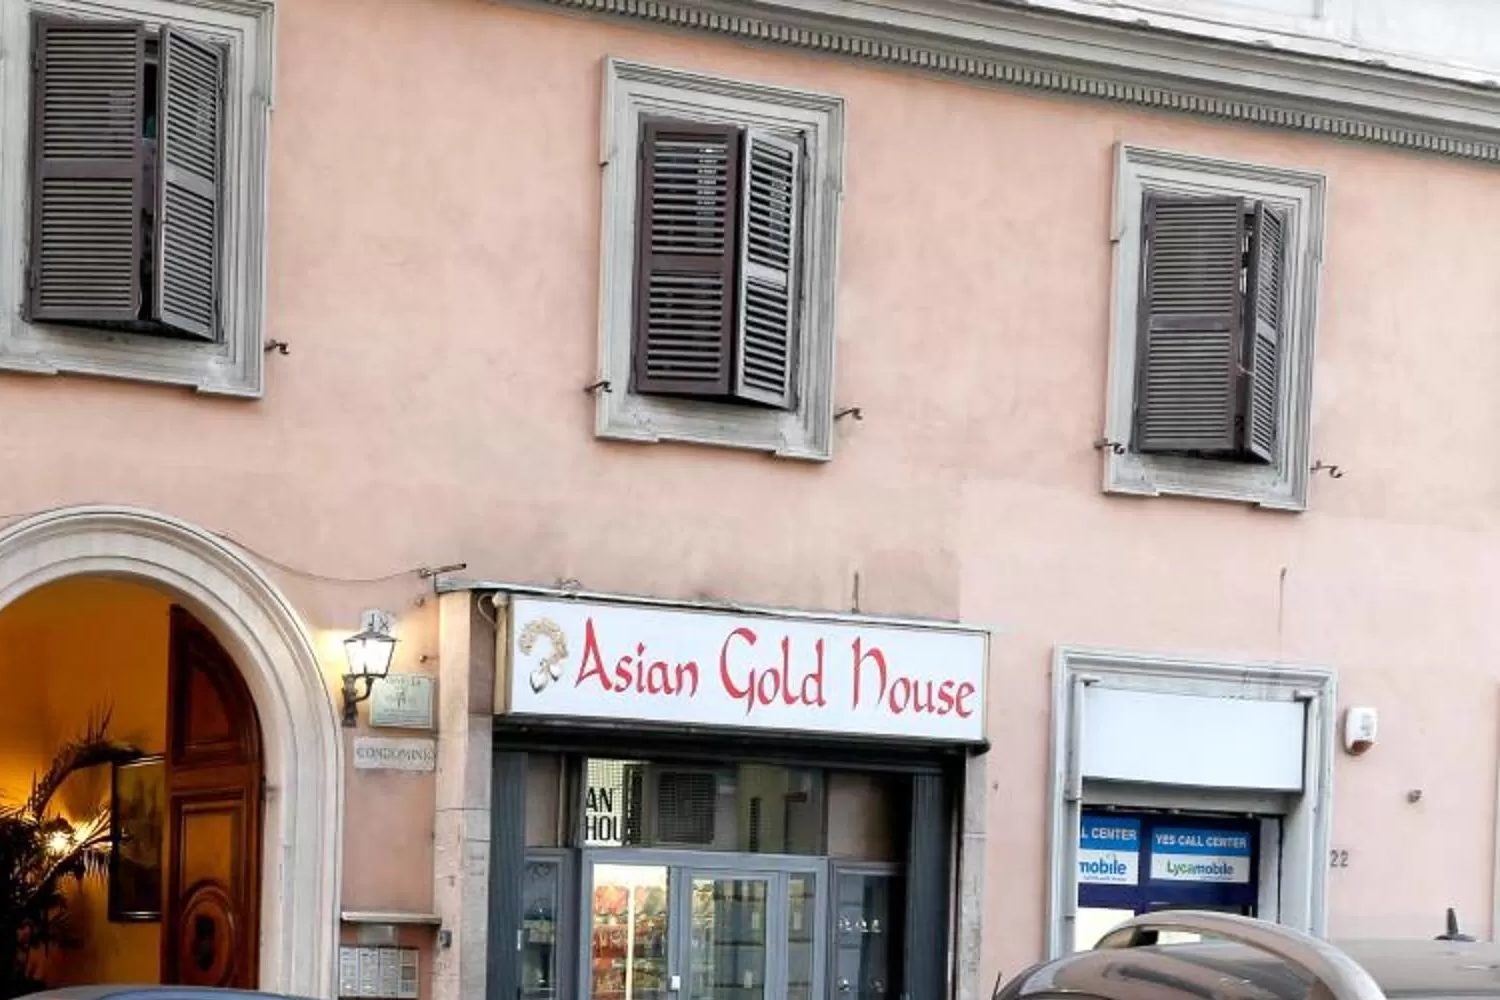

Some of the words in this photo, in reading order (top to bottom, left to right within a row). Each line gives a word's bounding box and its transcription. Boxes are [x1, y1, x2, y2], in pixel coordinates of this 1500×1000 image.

[574, 617, 699, 698] Asian
[719, 627, 827, 716] Gold
[1091, 827, 1137, 841] CENTER
[1156, 834, 1175, 845] YES
[1178, 835, 1204, 847] CALL
[1205, 837, 1247, 849] CENTER
[1167, 861, 1234, 877] Lycamobile
